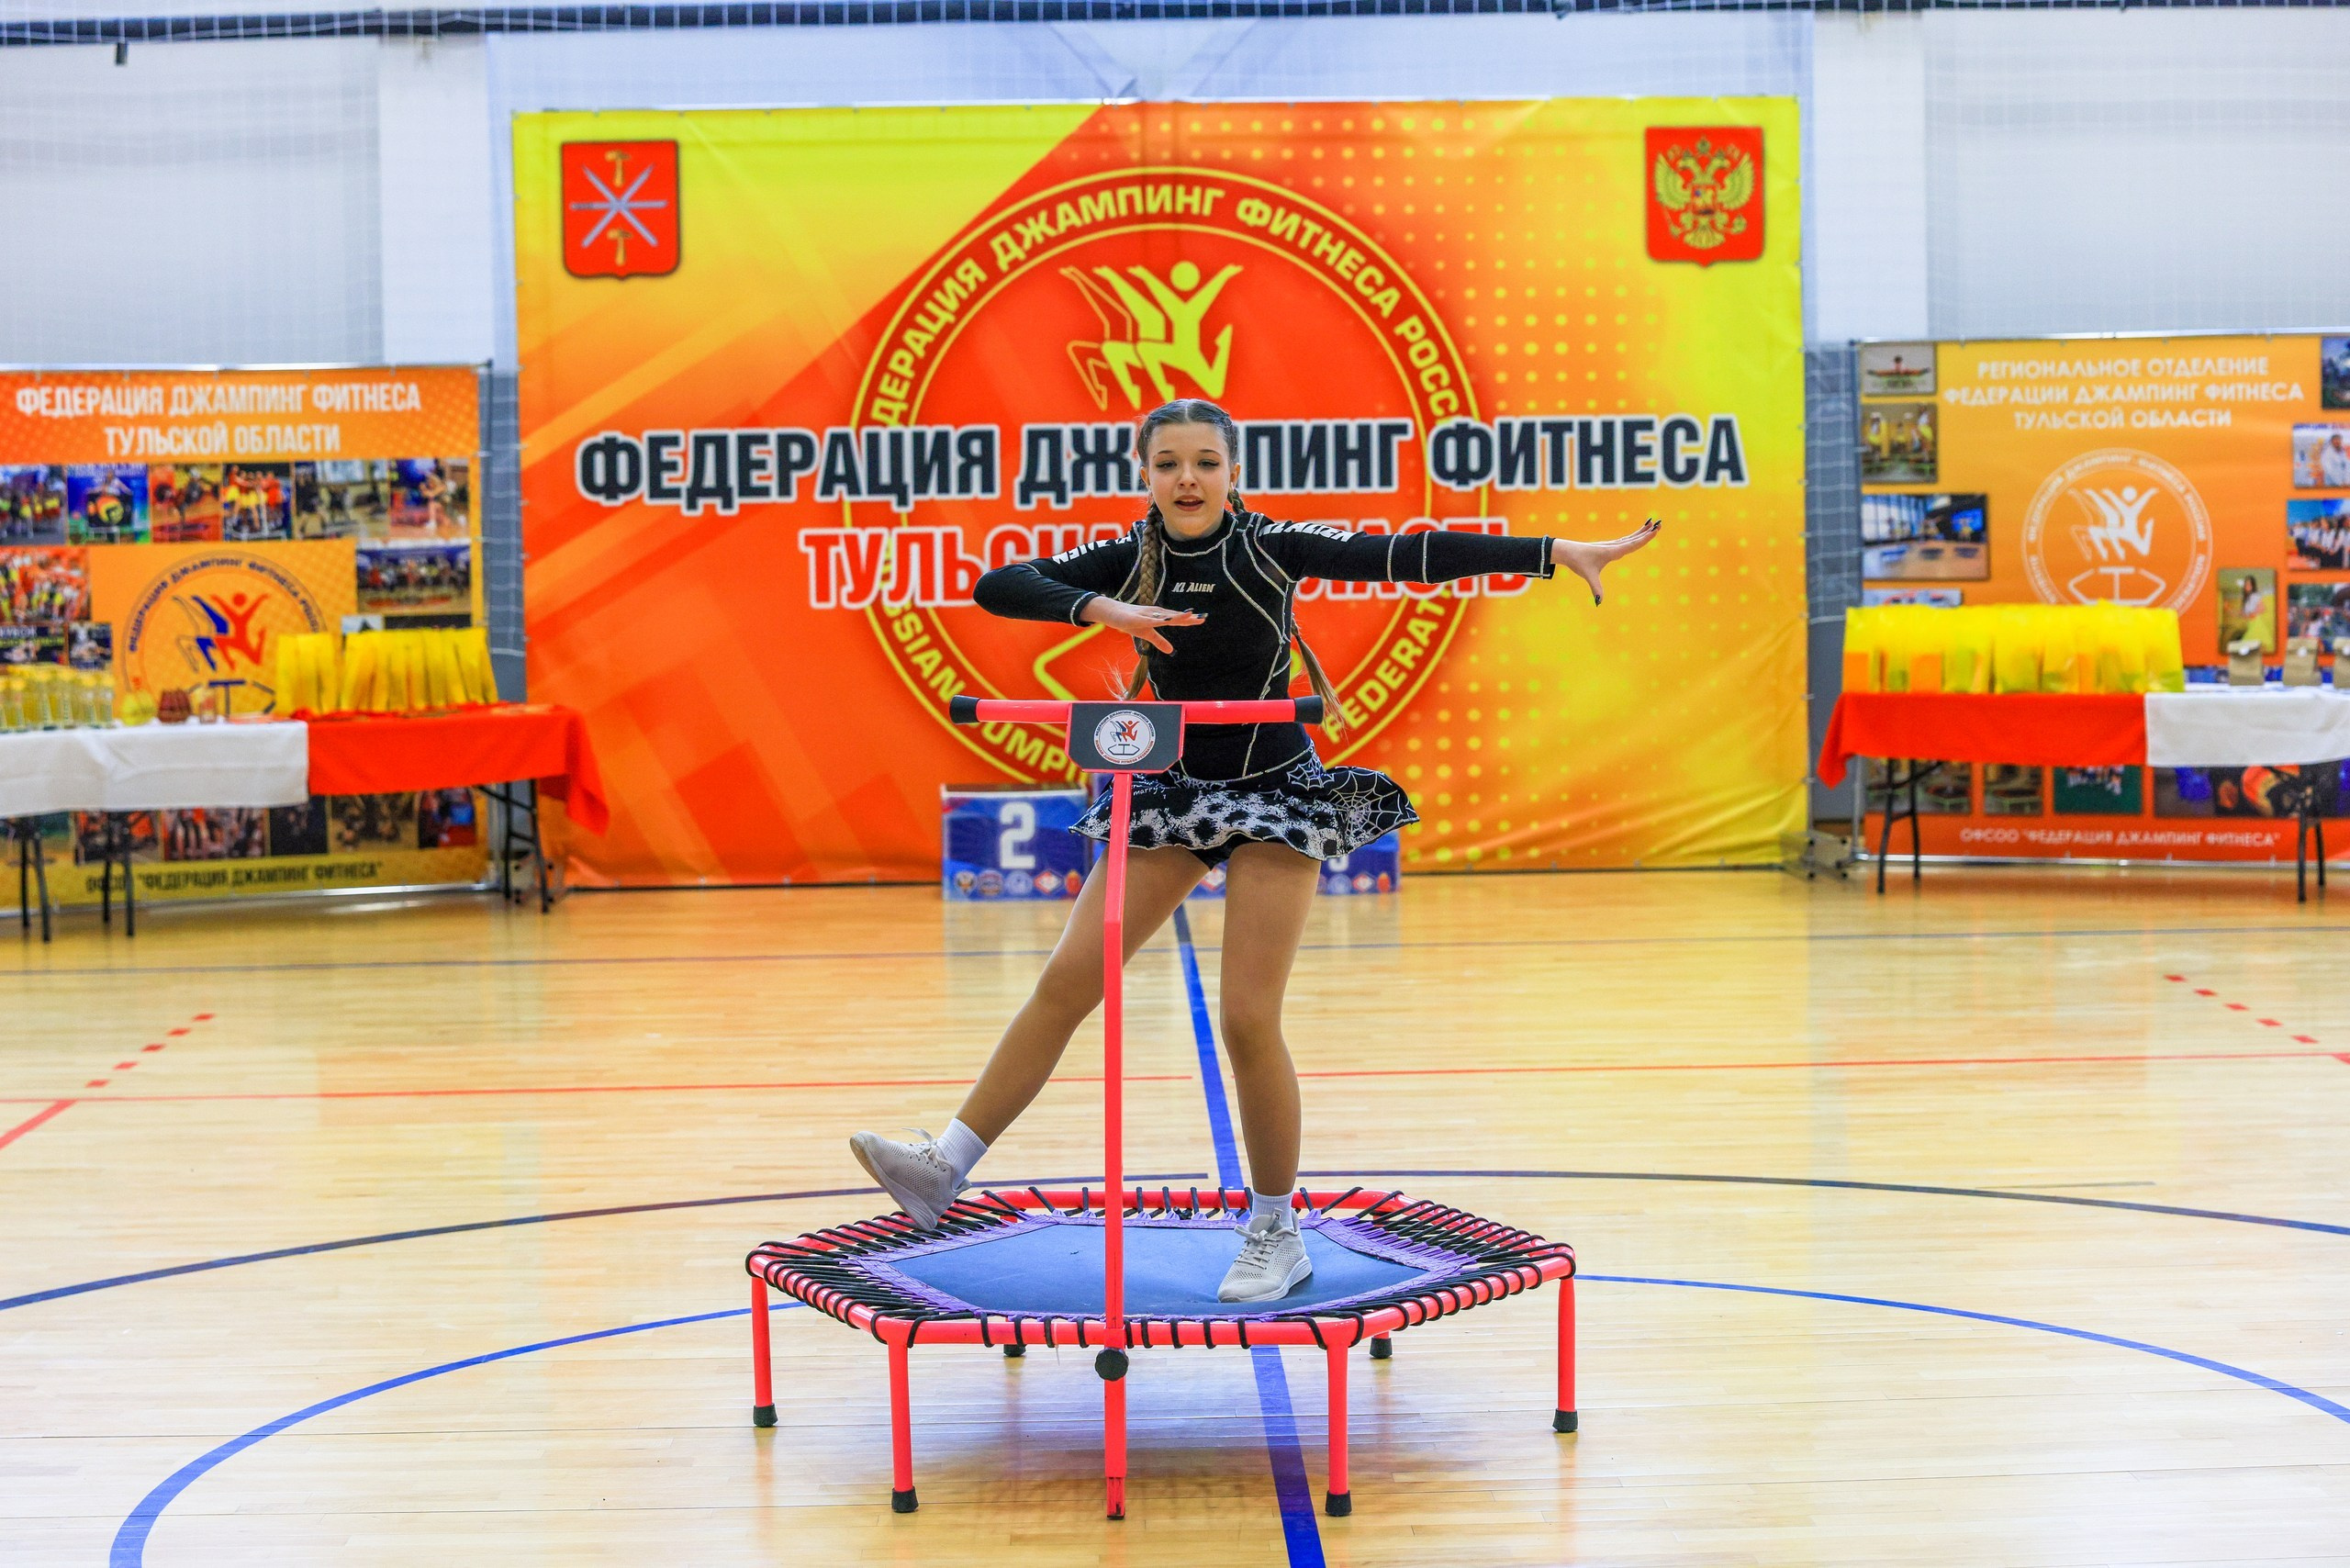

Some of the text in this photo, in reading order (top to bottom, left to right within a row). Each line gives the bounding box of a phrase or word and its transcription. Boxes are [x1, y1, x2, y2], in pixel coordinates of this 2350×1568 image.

[870, 184, 1462, 427] ДЕРАЦИЯ ДЖАМПИНГ ФИТНЕСА РОСС
[1977, 356, 2269, 379] РЕГИОНАЛЬНОЕ ОТДЕЛЕНИЕ
[16, 382, 421, 418] ФЕДЕРАЦИЯ ДЖАМПИНГ ФИТНЕСА
[1943, 382, 2305, 406] ФЕДЕРАЦИИ ДЖАМПИНГ ФИТНЕСА
[2014, 407, 2232, 430] ТУЛЬСКОЙ ОБЛАСТИ
[105, 420, 341, 455] ТУЛЬСКОЙ ОБЛАСТИ
[576, 412, 1748, 512] ФЕДЕРАЦИЯ ДЖПИНГ ФИТНЕСА
[1186, 582, 1216, 593] ALIEN
[1000, 801, 1035, 868] 2
